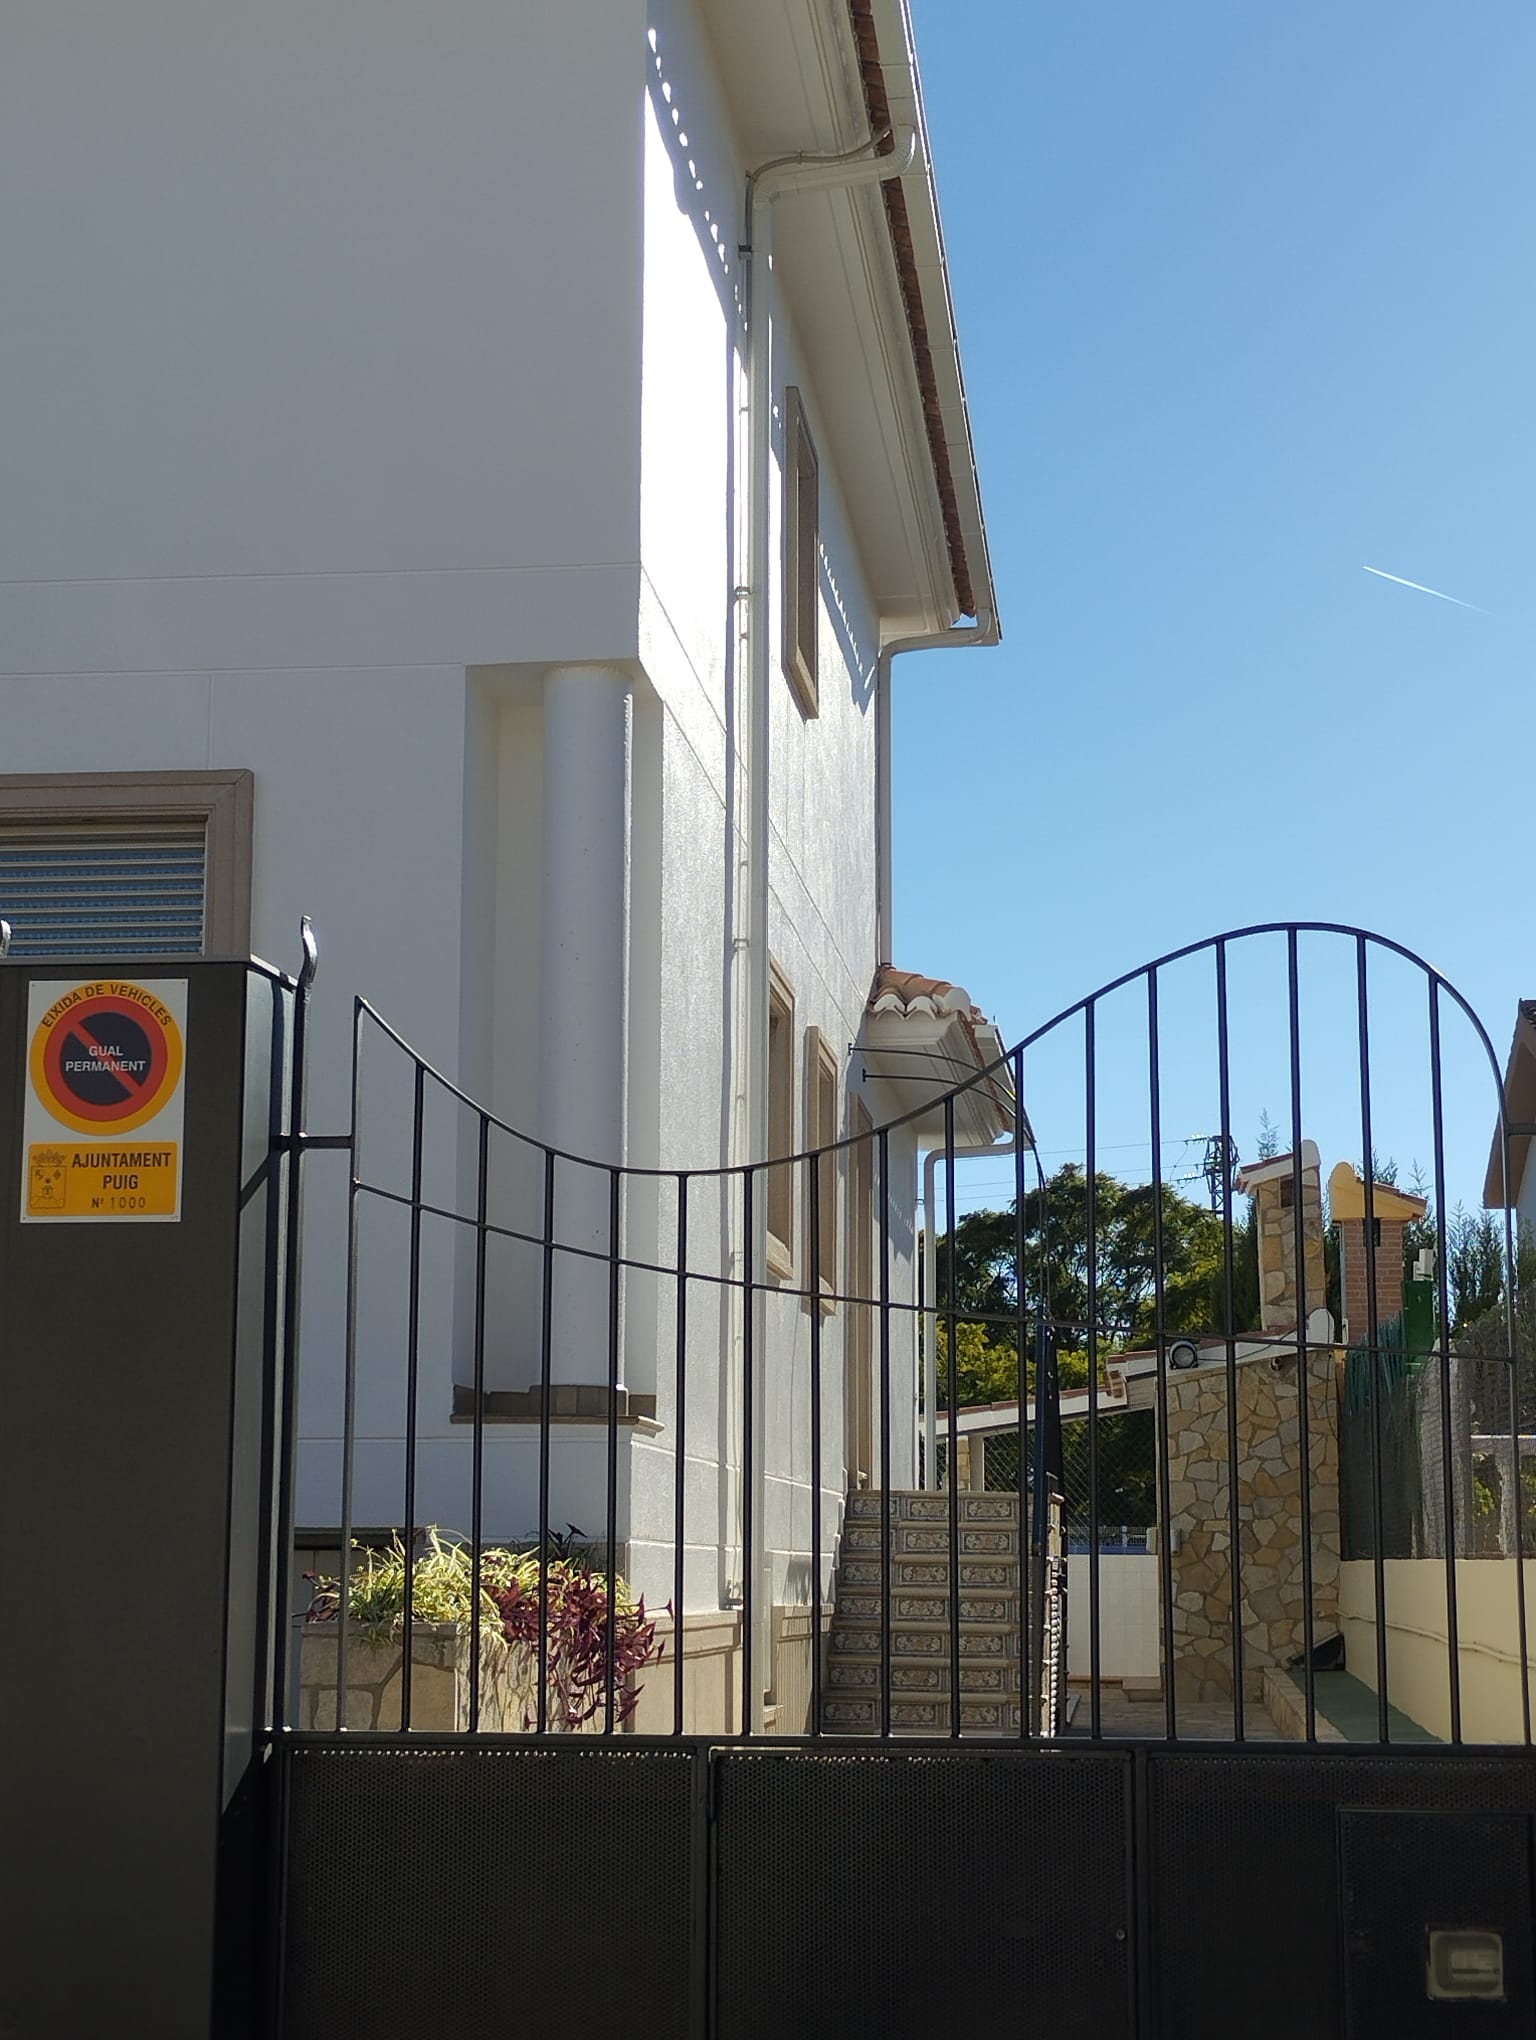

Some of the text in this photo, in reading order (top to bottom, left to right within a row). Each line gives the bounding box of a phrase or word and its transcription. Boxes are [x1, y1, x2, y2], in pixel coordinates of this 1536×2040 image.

[42, 984, 172, 1028] EIXIDA DE VEHICLES
[89, 1045, 124, 1057] GUAL
[65, 1060, 146, 1072] PERMANENT
[72, 1152, 171, 1168] AJUNTAMENT
[102, 1175, 138, 1190] PUIG
